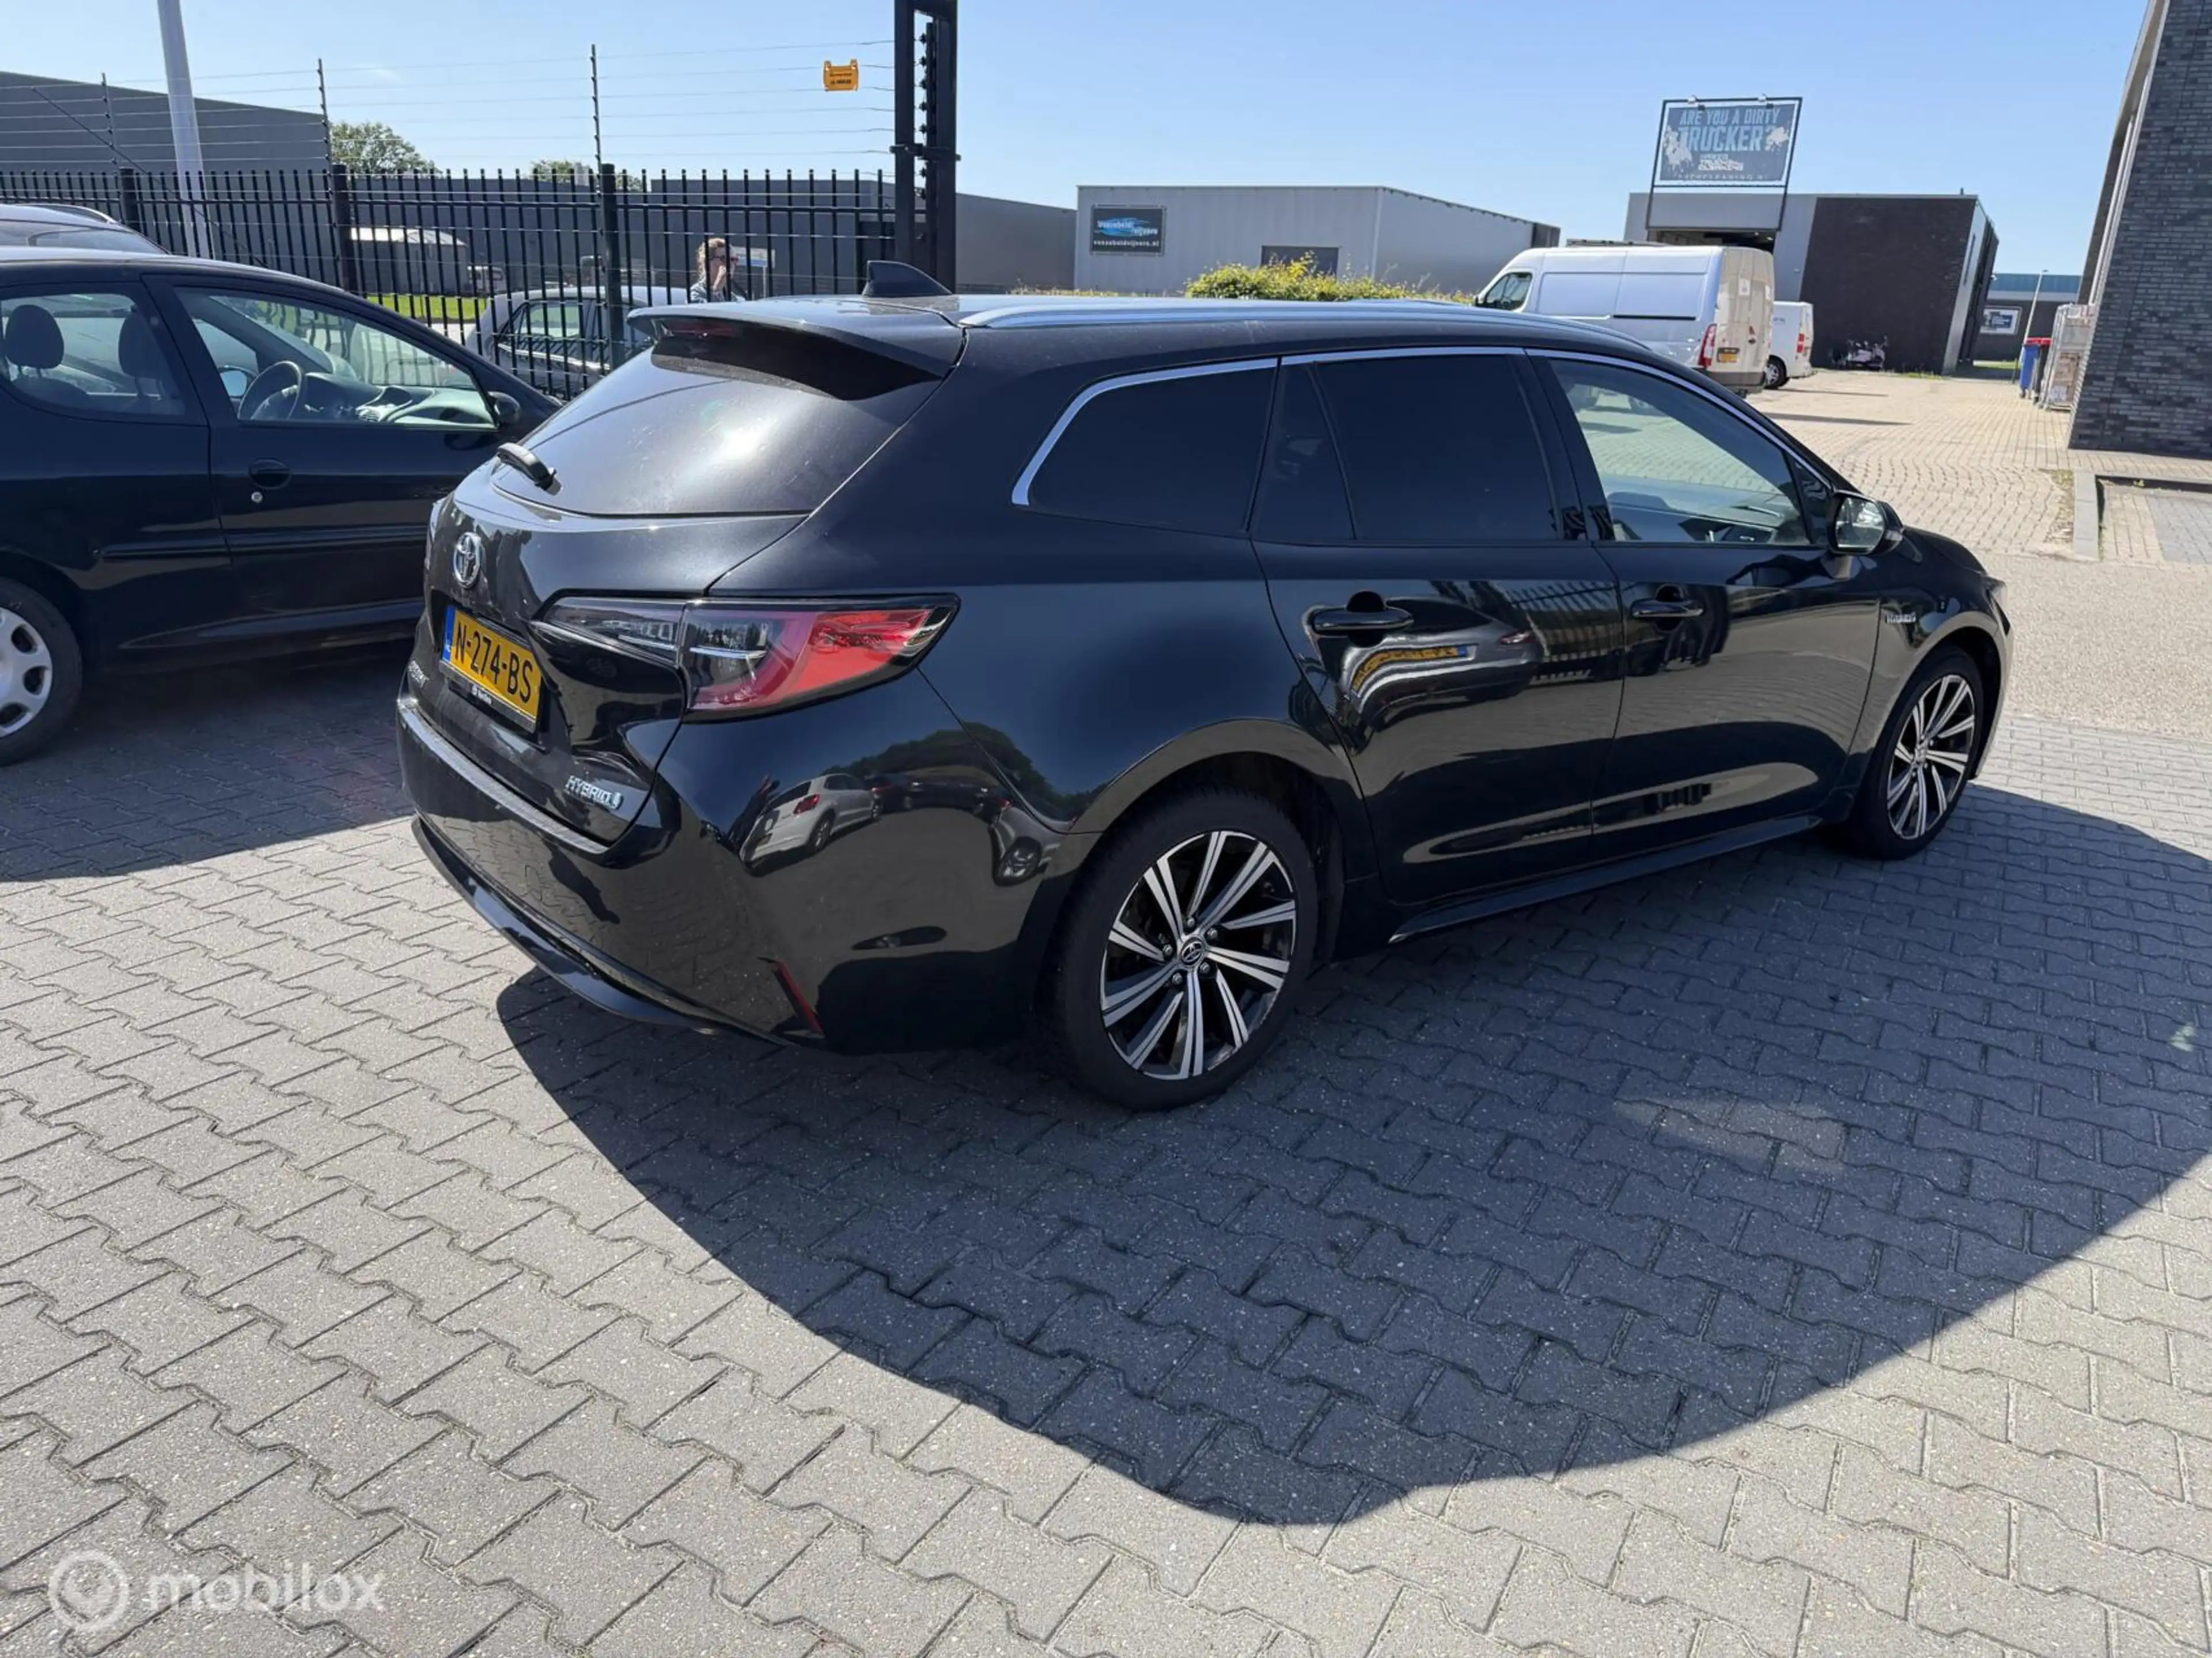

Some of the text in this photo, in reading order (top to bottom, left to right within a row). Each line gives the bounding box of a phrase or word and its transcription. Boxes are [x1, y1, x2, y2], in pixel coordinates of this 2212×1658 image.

[1679, 108, 1781, 126] ARE YOU A DIRTY
[454, 621, 533, 704] N-274-BS
[565, 775, 613, 807] HYBRID
